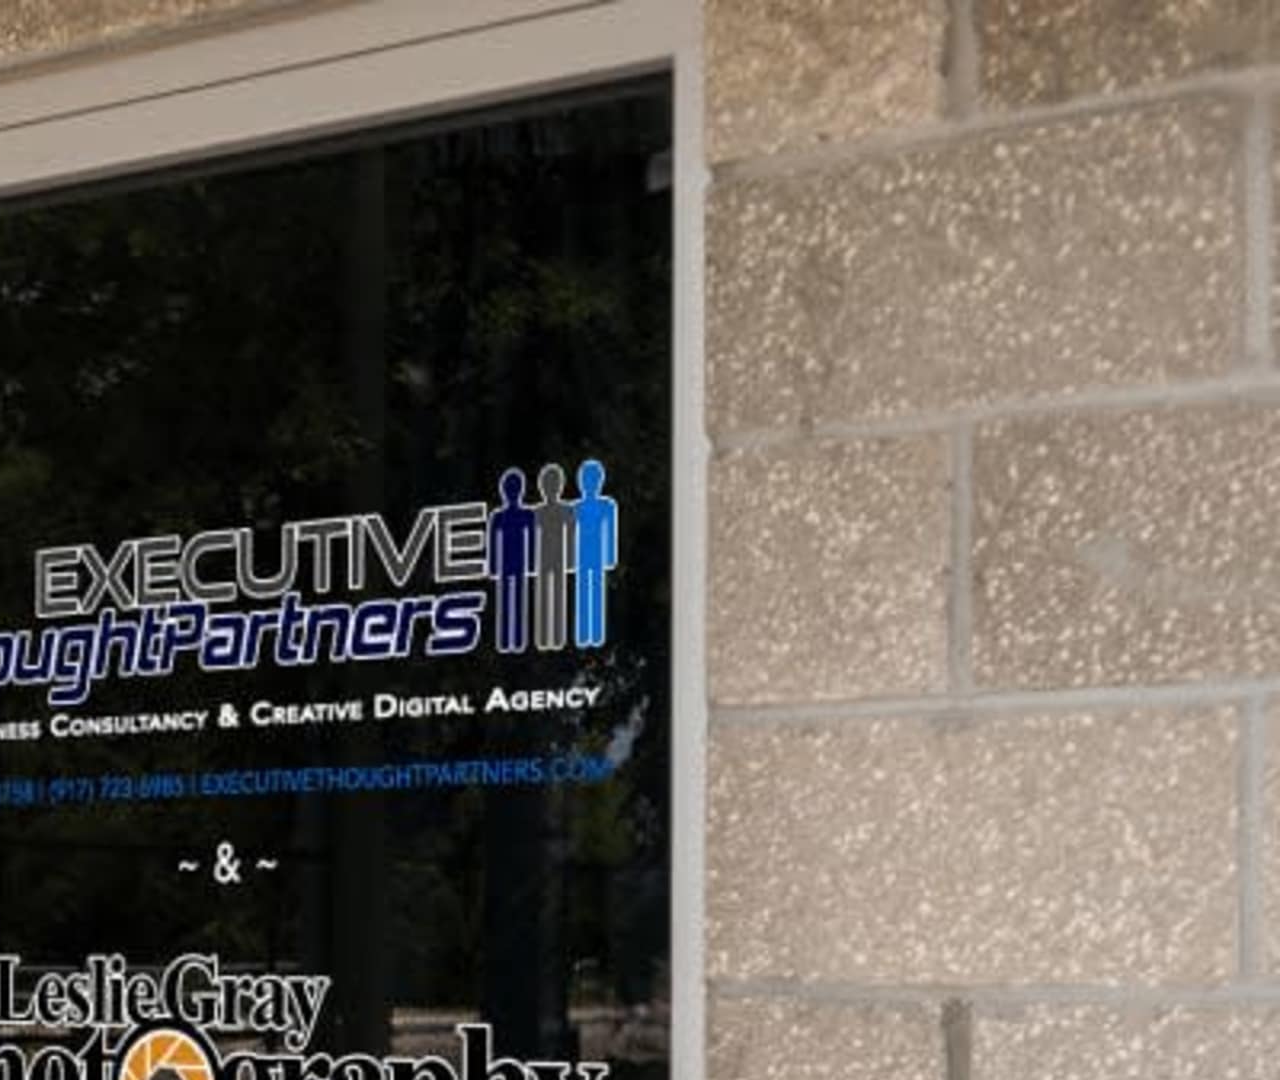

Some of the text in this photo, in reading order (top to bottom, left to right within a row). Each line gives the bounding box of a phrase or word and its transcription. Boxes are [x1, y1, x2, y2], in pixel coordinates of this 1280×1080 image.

[35, 502, 488, 618] EXECUTIVE
[217, 703, 239, 728] &
[213, 840, 241, 885] &
